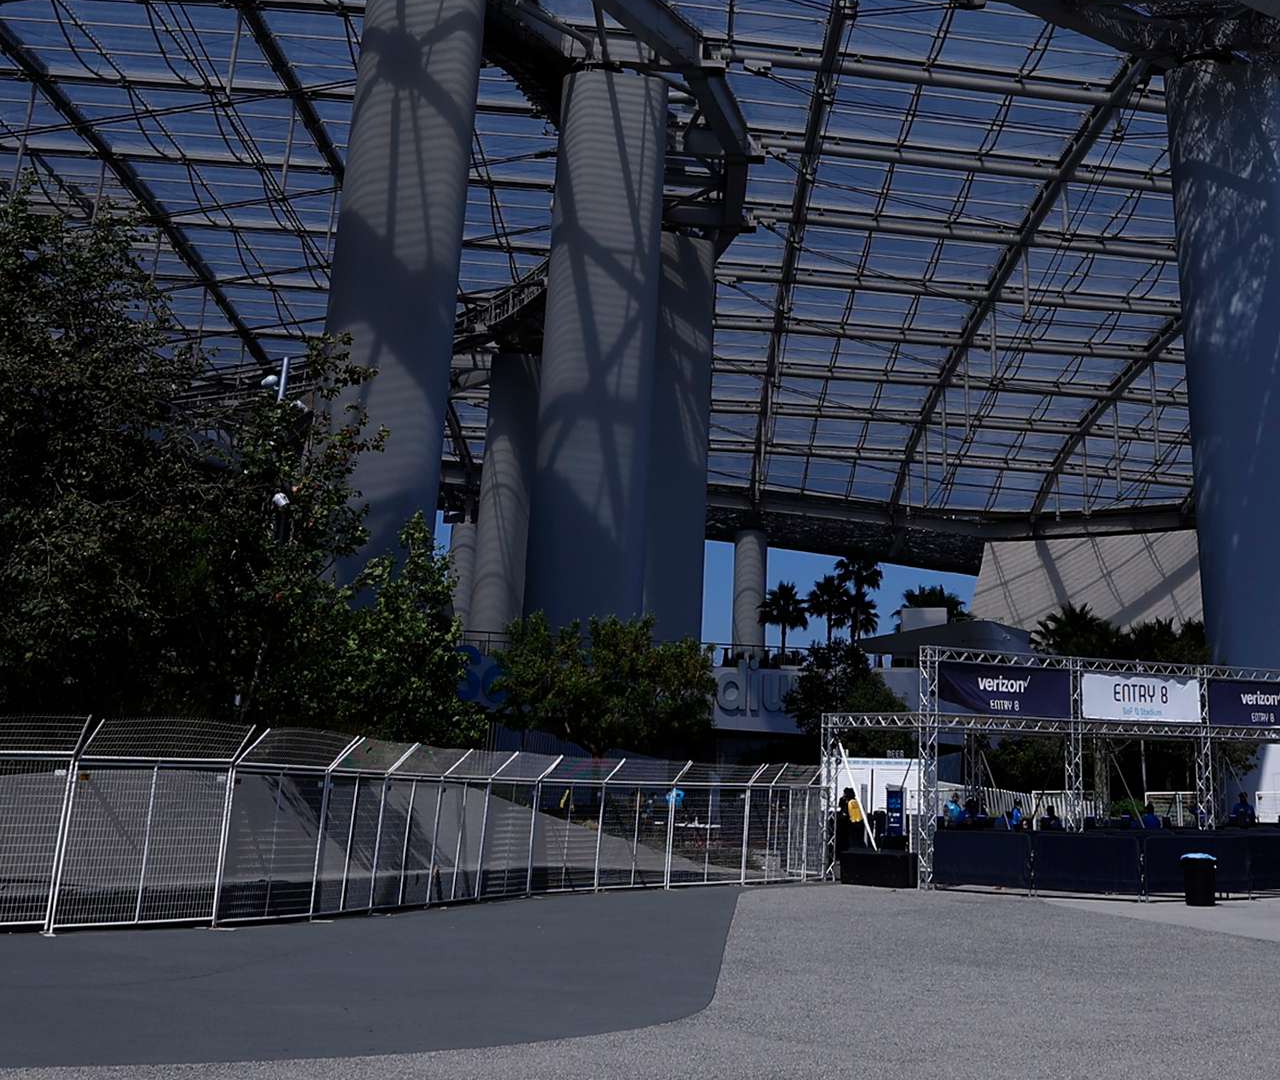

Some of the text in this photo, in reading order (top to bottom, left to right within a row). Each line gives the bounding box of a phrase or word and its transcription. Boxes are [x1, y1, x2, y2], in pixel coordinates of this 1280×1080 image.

[977, 675, 1025, 693] verizon
[1113, 684, 1168, 704] ENTRY 8
[1240, 691, 1278, 705] verizon
[989, 699, 1013, 710] ENTRY
